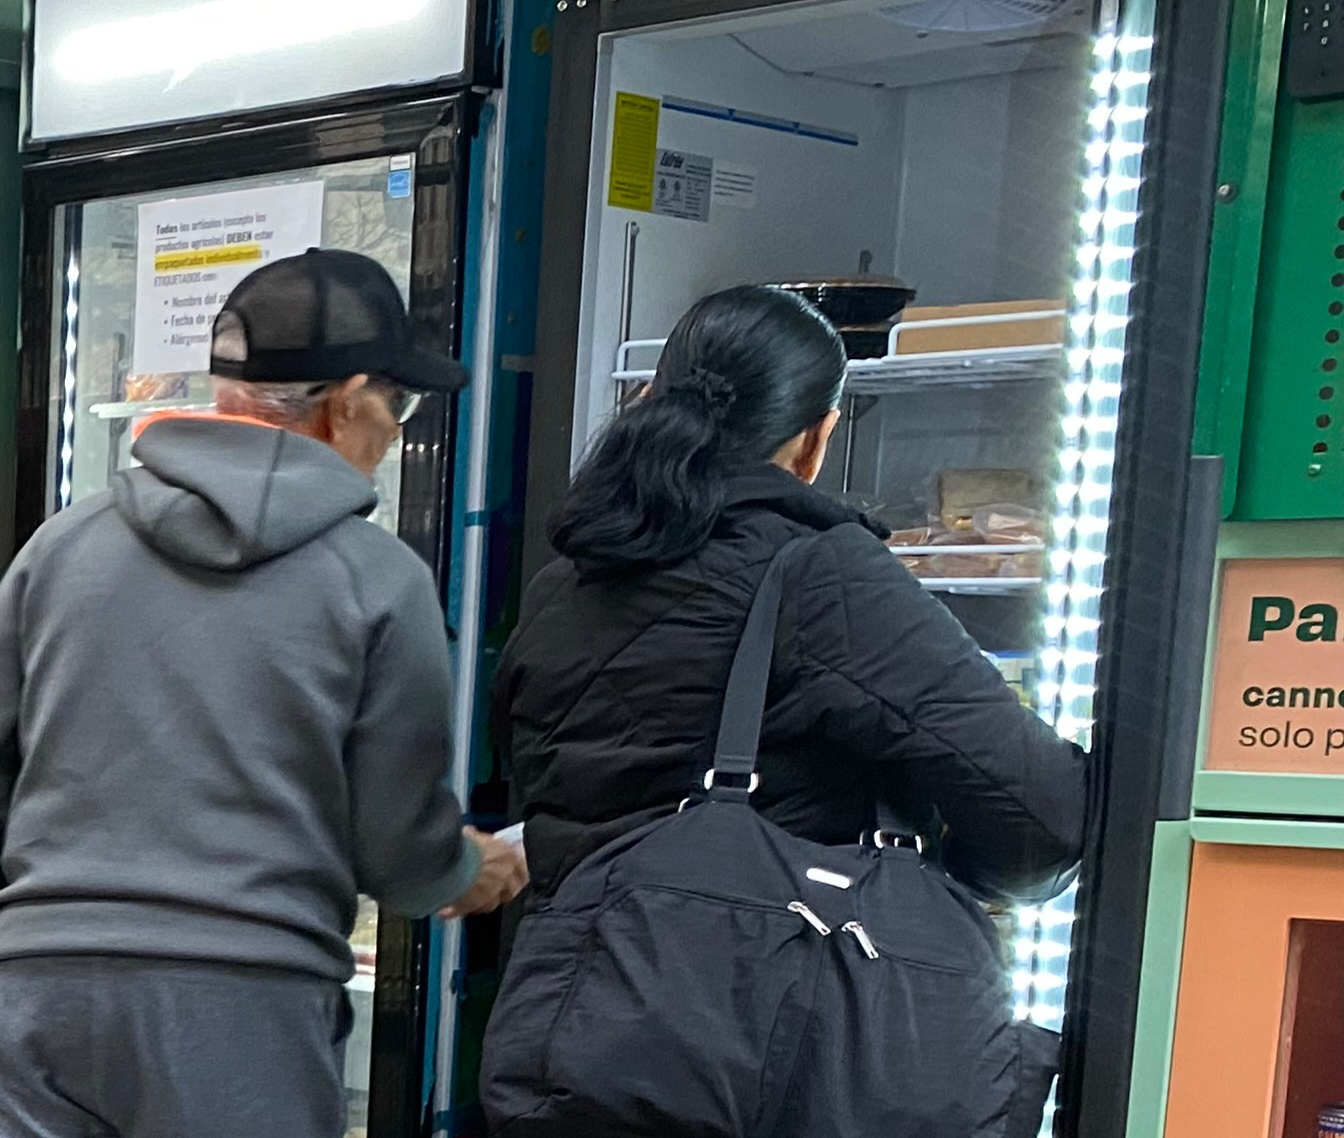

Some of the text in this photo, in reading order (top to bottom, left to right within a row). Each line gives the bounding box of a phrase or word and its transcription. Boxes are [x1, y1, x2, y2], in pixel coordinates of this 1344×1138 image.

[226, 231, 252, 244] DEBEN
[1248, 596, 1344, 642] Pa
[1238, 721, 1314, 748] solo
